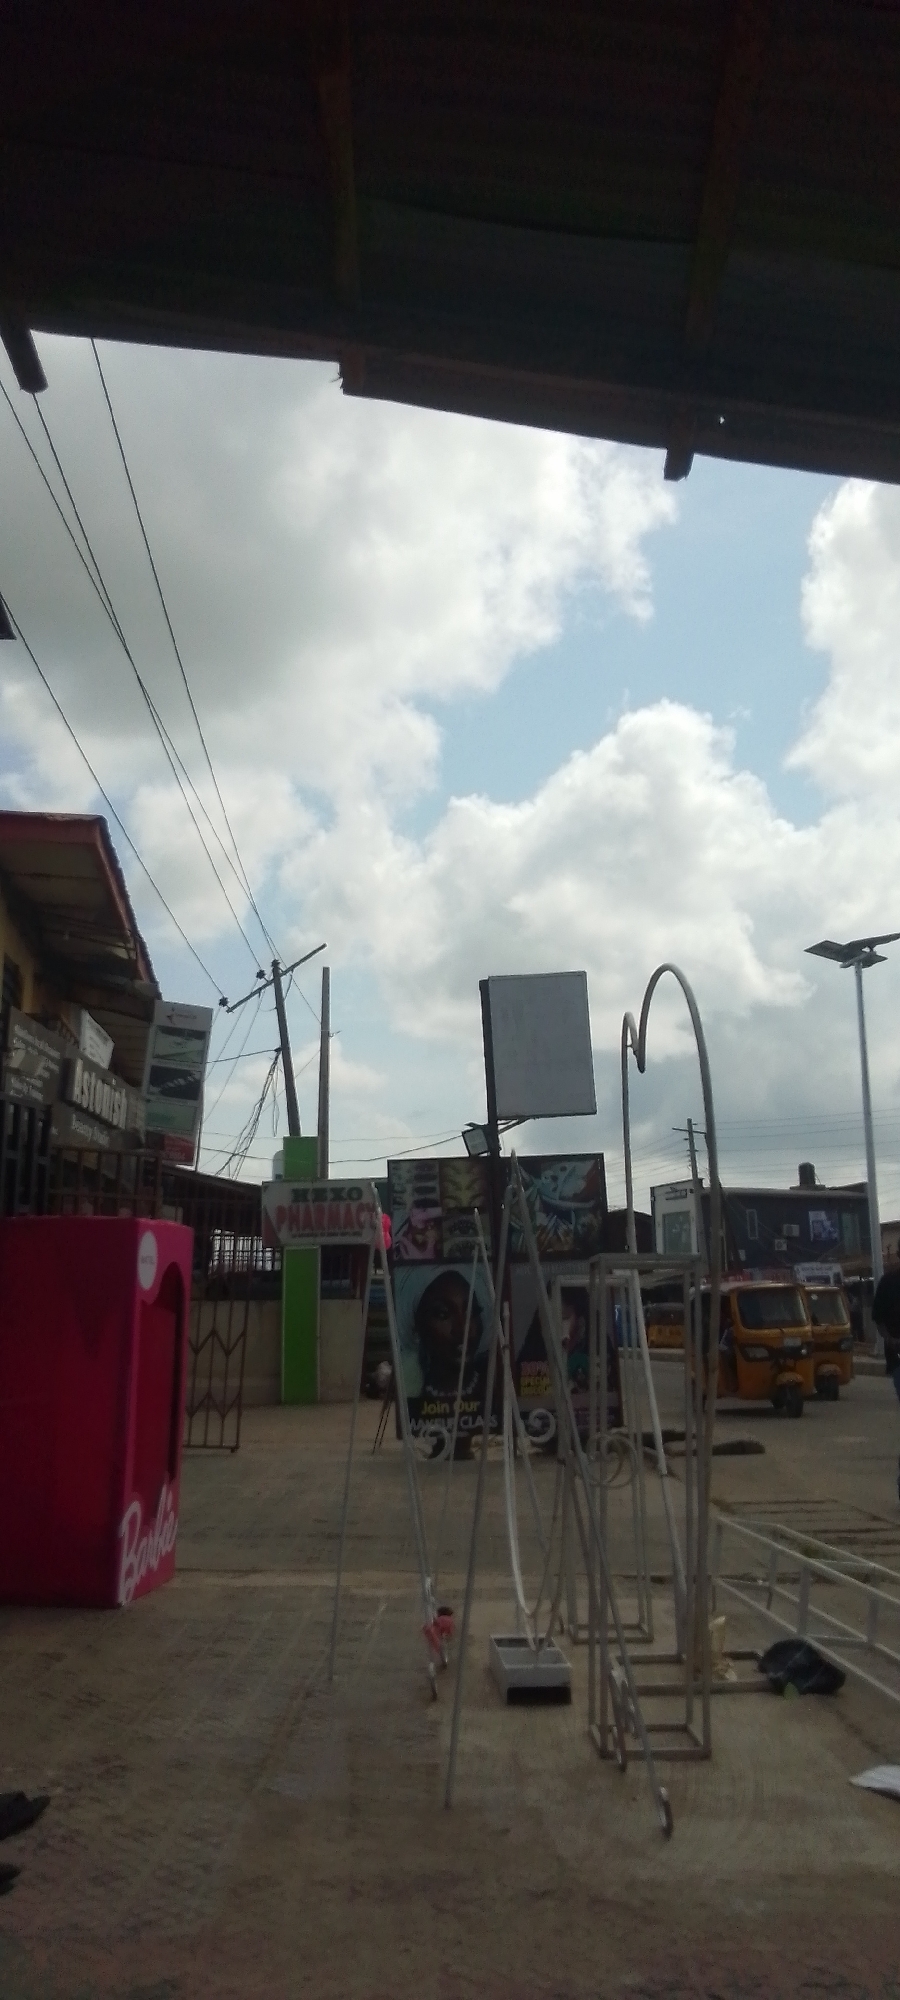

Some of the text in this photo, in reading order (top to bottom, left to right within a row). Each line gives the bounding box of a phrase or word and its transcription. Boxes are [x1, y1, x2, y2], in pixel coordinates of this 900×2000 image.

[73, 1057, 127, 1130] Astonish
[421, 1400, 450, 1415] Join
[459, 1414, 499, 1429] CLAS
[118, 1483, 179, 1607] Barbie
